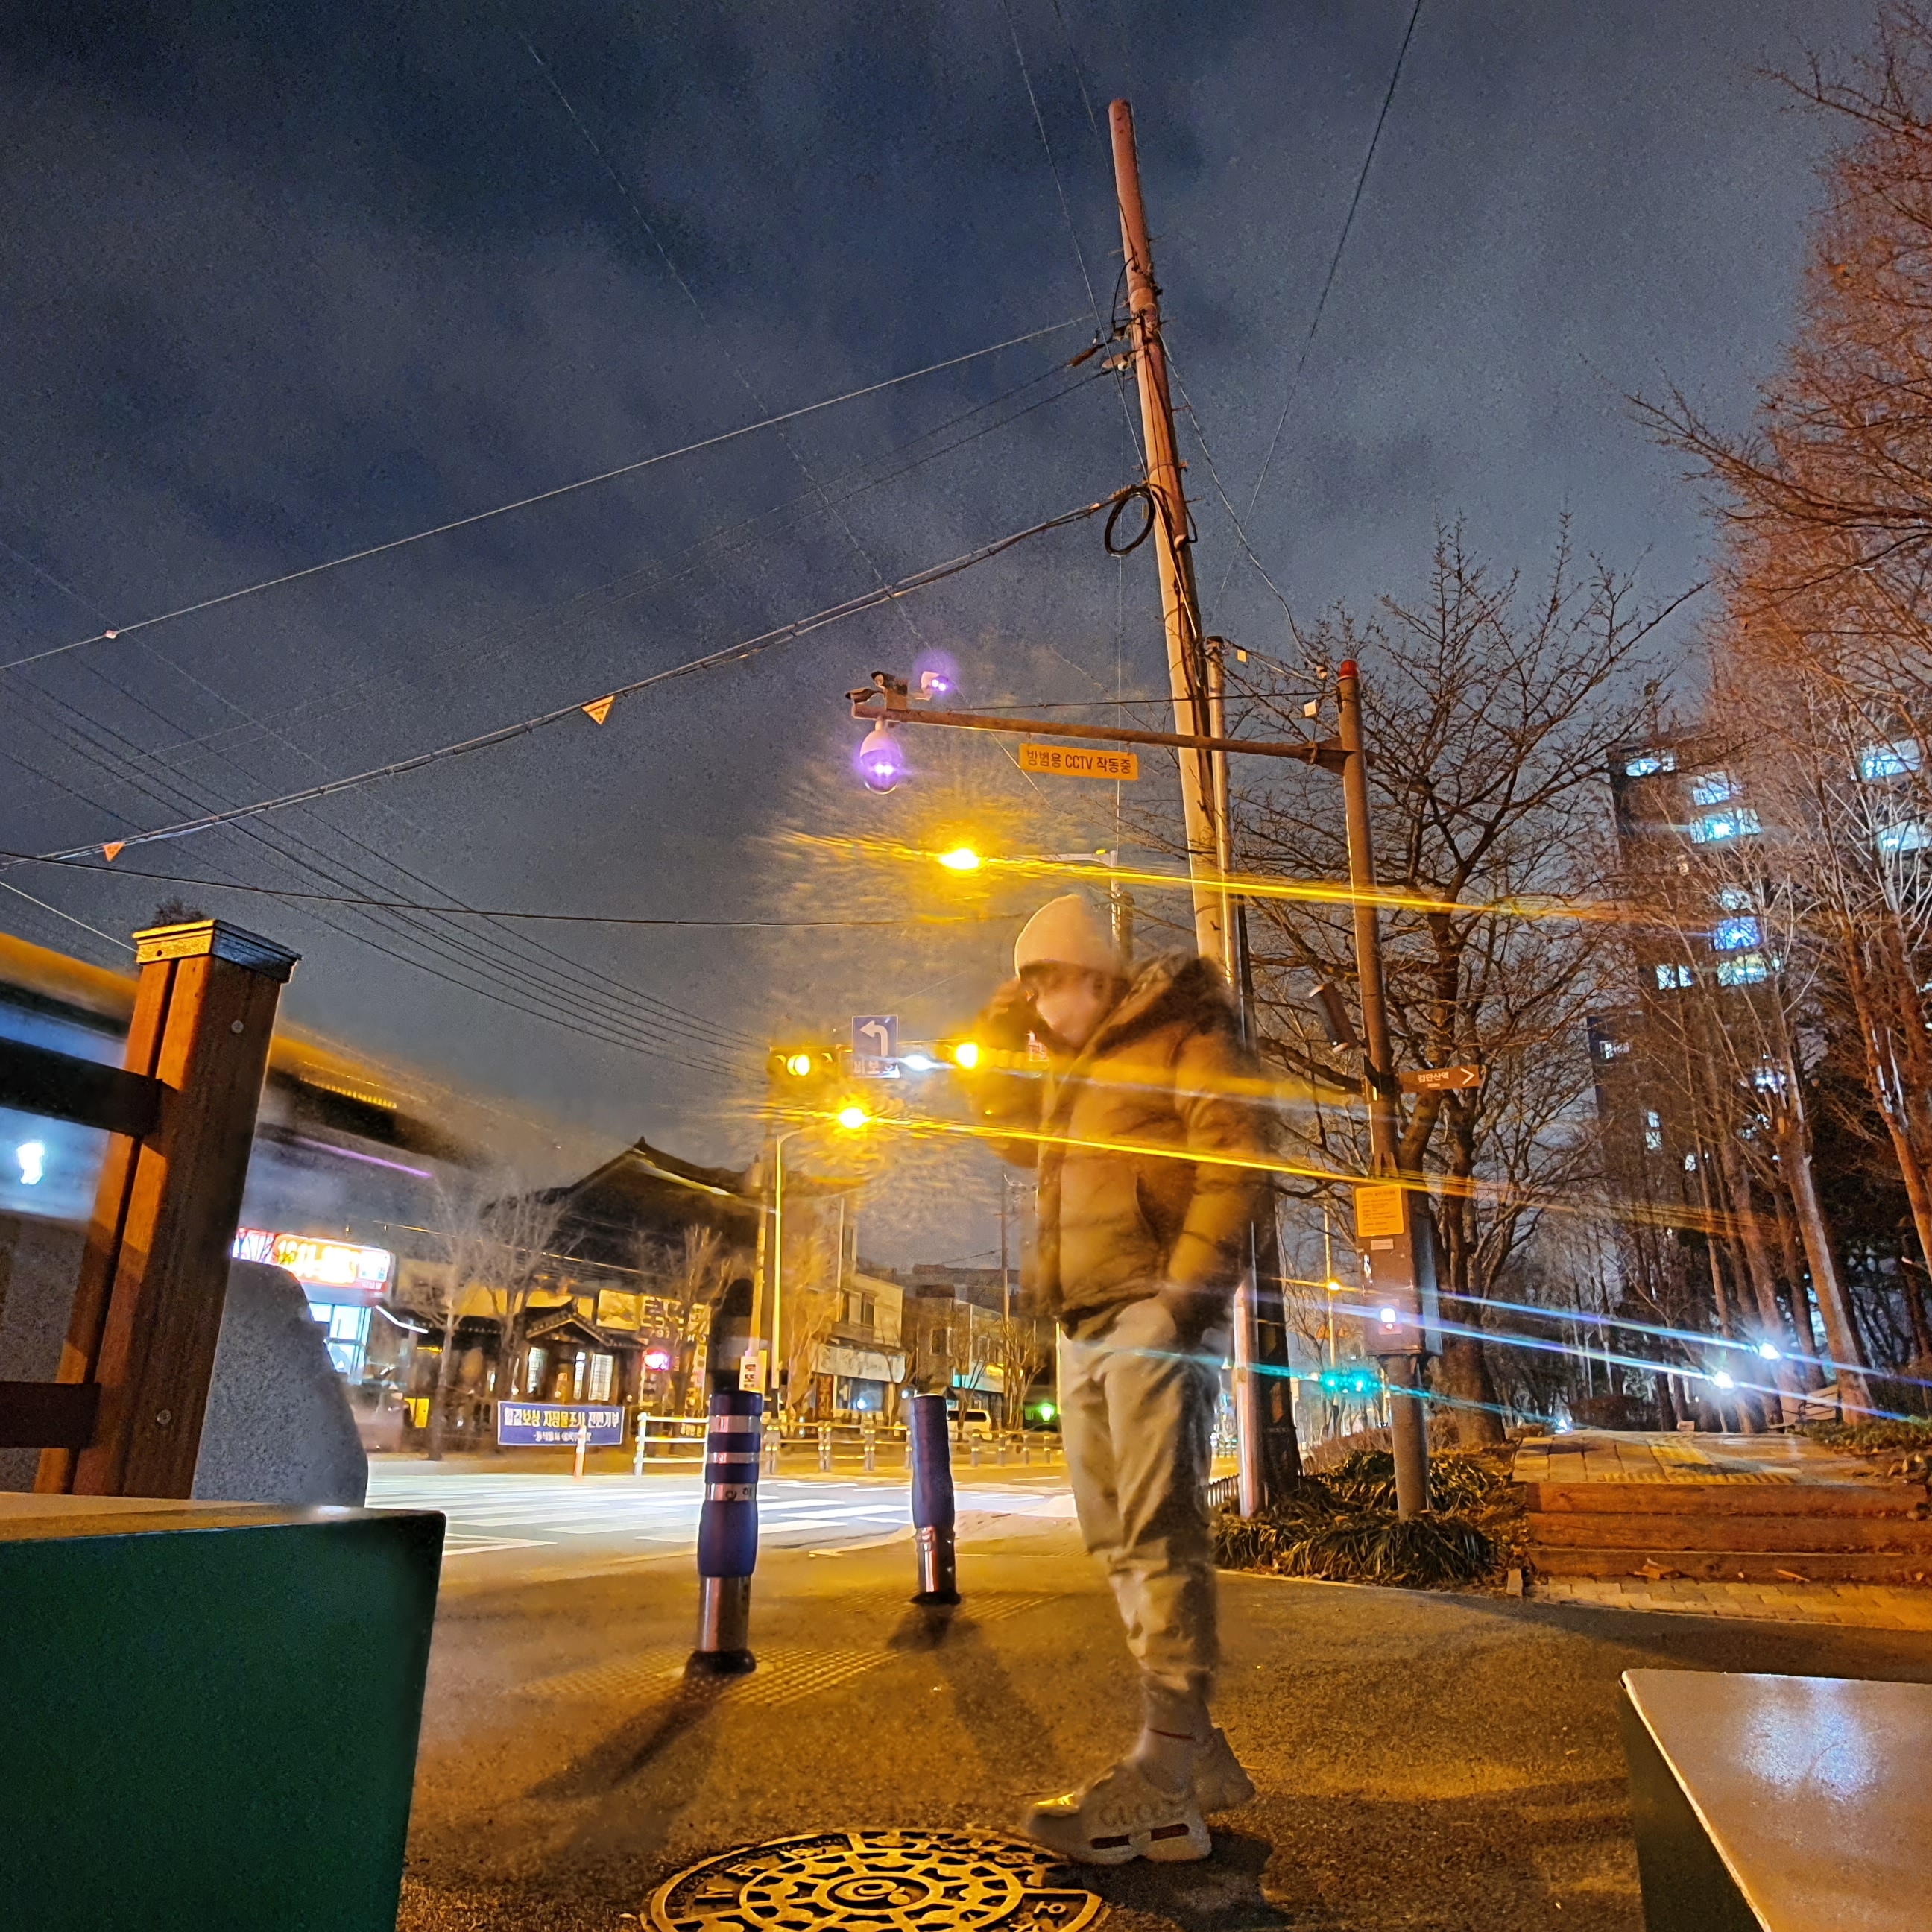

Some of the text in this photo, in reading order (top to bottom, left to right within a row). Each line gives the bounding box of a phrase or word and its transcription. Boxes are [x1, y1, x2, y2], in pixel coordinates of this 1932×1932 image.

[1026, 750, 1131, 774] 방범용 CCTV 작동중
[853, 1058, 895, 1076] 비보호
[1418, 1071, 1449, 1083] 검단산역
